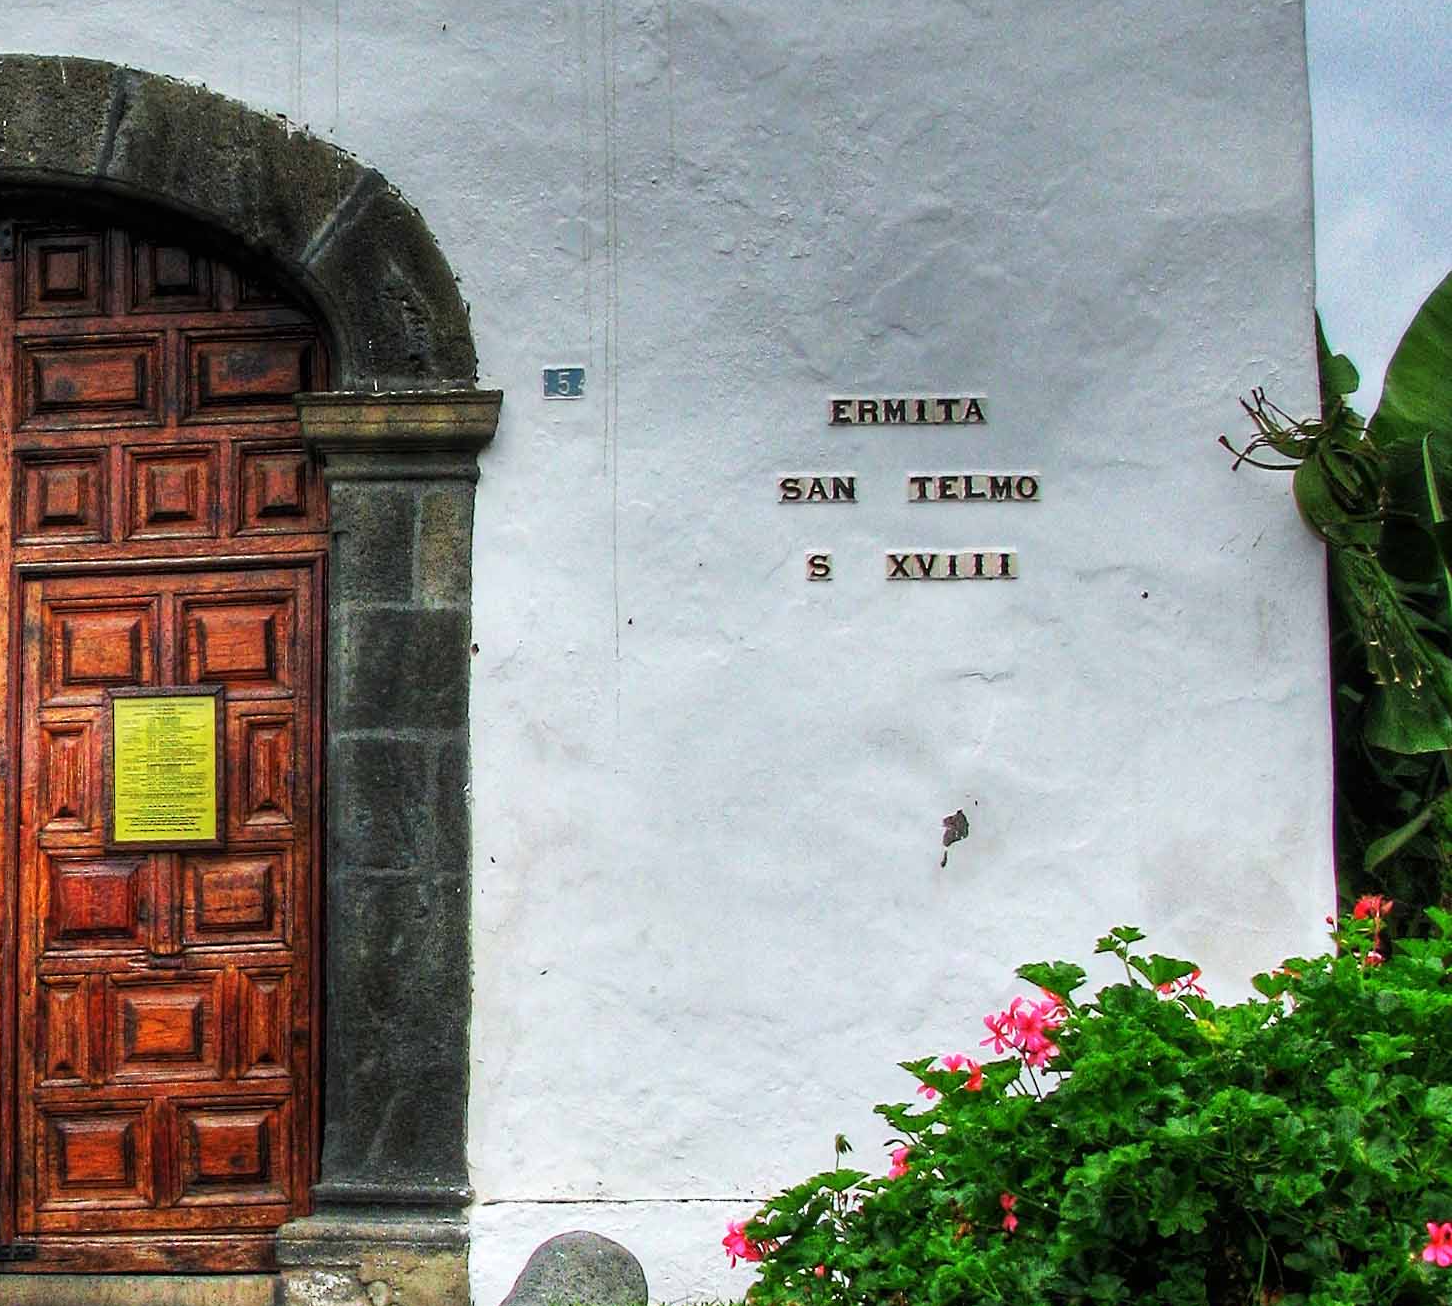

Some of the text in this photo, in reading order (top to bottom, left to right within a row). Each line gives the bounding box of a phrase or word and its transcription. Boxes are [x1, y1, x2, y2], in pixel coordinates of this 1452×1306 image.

[558, 372, 570, 394] 5
[830, 398, 985, 423] ERMITA
[778, 476, 1038, 500] SAN TELMO
[807, 553, 1011, 577] S XVIII
